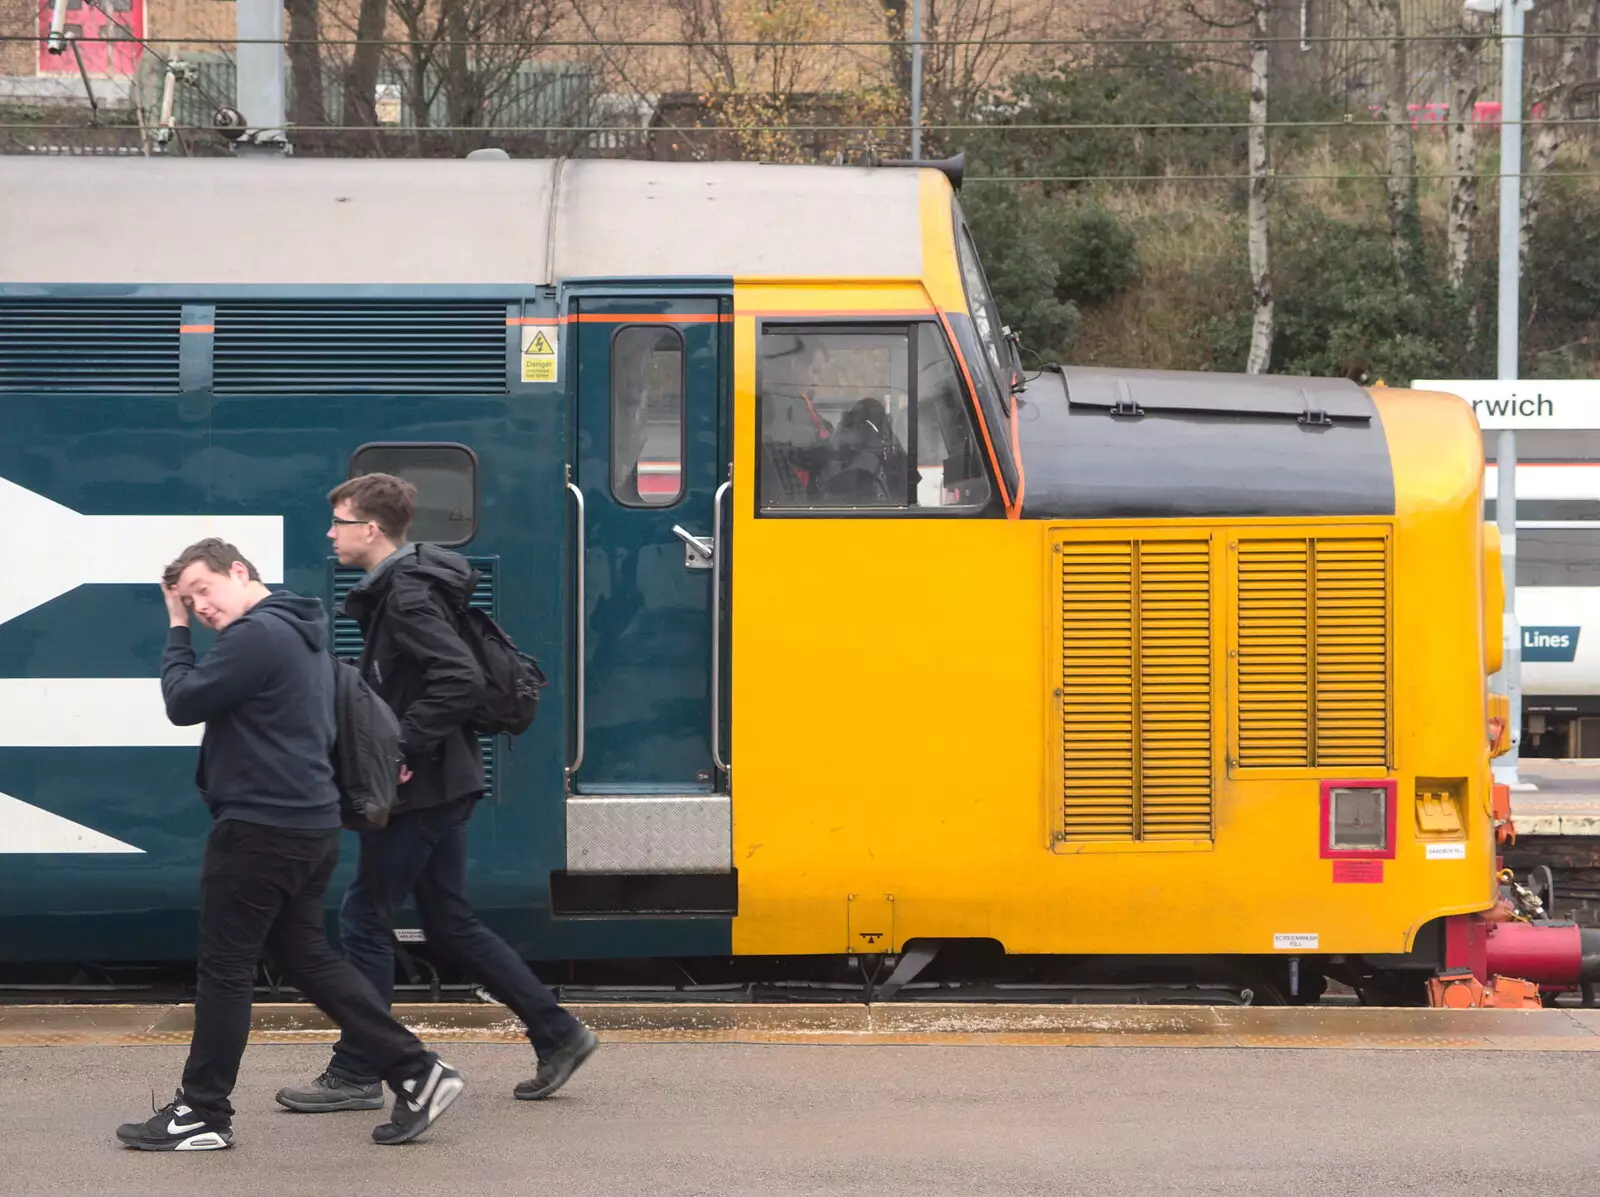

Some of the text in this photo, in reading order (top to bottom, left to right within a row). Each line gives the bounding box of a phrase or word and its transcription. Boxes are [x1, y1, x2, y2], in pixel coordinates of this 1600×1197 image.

[526, 360, 553, 369] Danger
[1472, 393, 1554, 417] rwich
[1523, 631, 1570, 648] Lines
